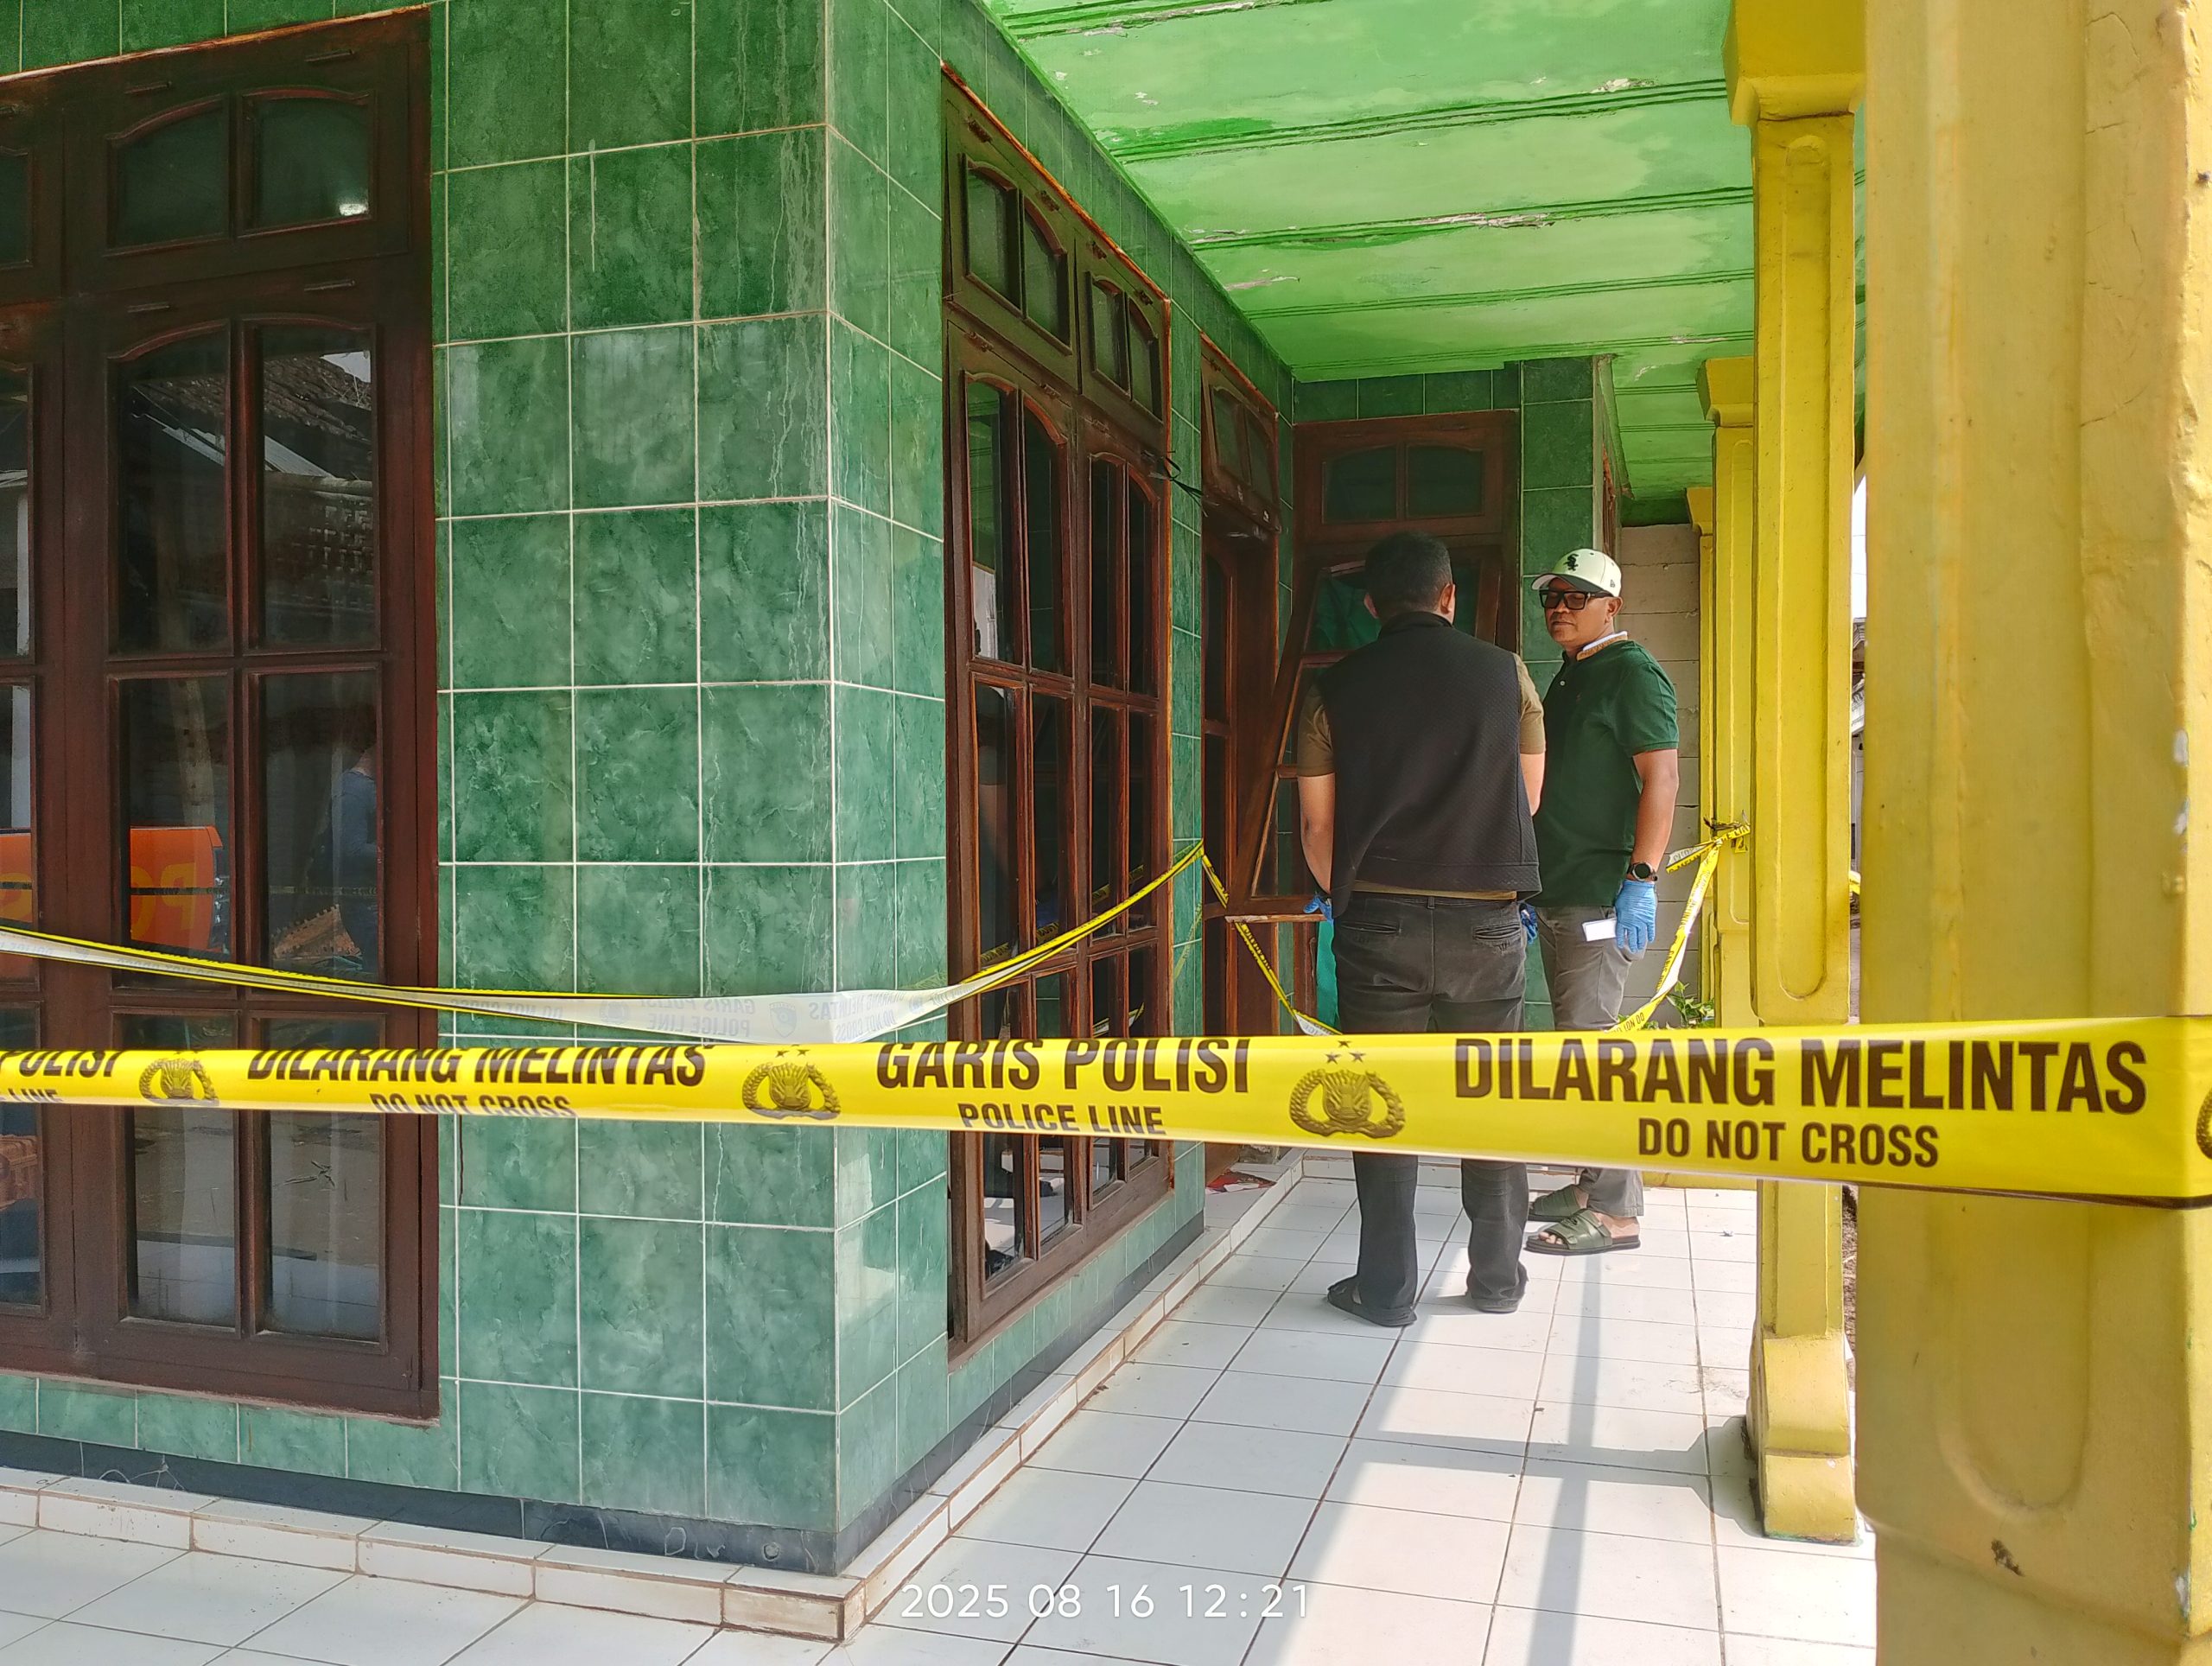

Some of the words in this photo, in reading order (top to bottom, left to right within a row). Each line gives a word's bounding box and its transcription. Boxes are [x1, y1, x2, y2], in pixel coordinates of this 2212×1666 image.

[248, 1048, 463, 1084] DILARANG
[474, 1043, 710, 1087] MELINTAS
[877, 1038, 1044, 1090] GARIS
[1064, 1037, 1251, 1094] POLISI
[1455, 1038, 1776, 1108] DILARANG
[1801, 1039, 2147, 1116] MELINTAS
[478, 1095, 577, 1117] CROSS
[957, 1103, 1081, 1133] POLICE
[1087, 1105, 1167, 1135] LINE
[1638, 1117, 1691, 1158] DO
[1707, 1120, 1787, 1162] NOT
[1801, 1122, 1940, 1168] CROSS
